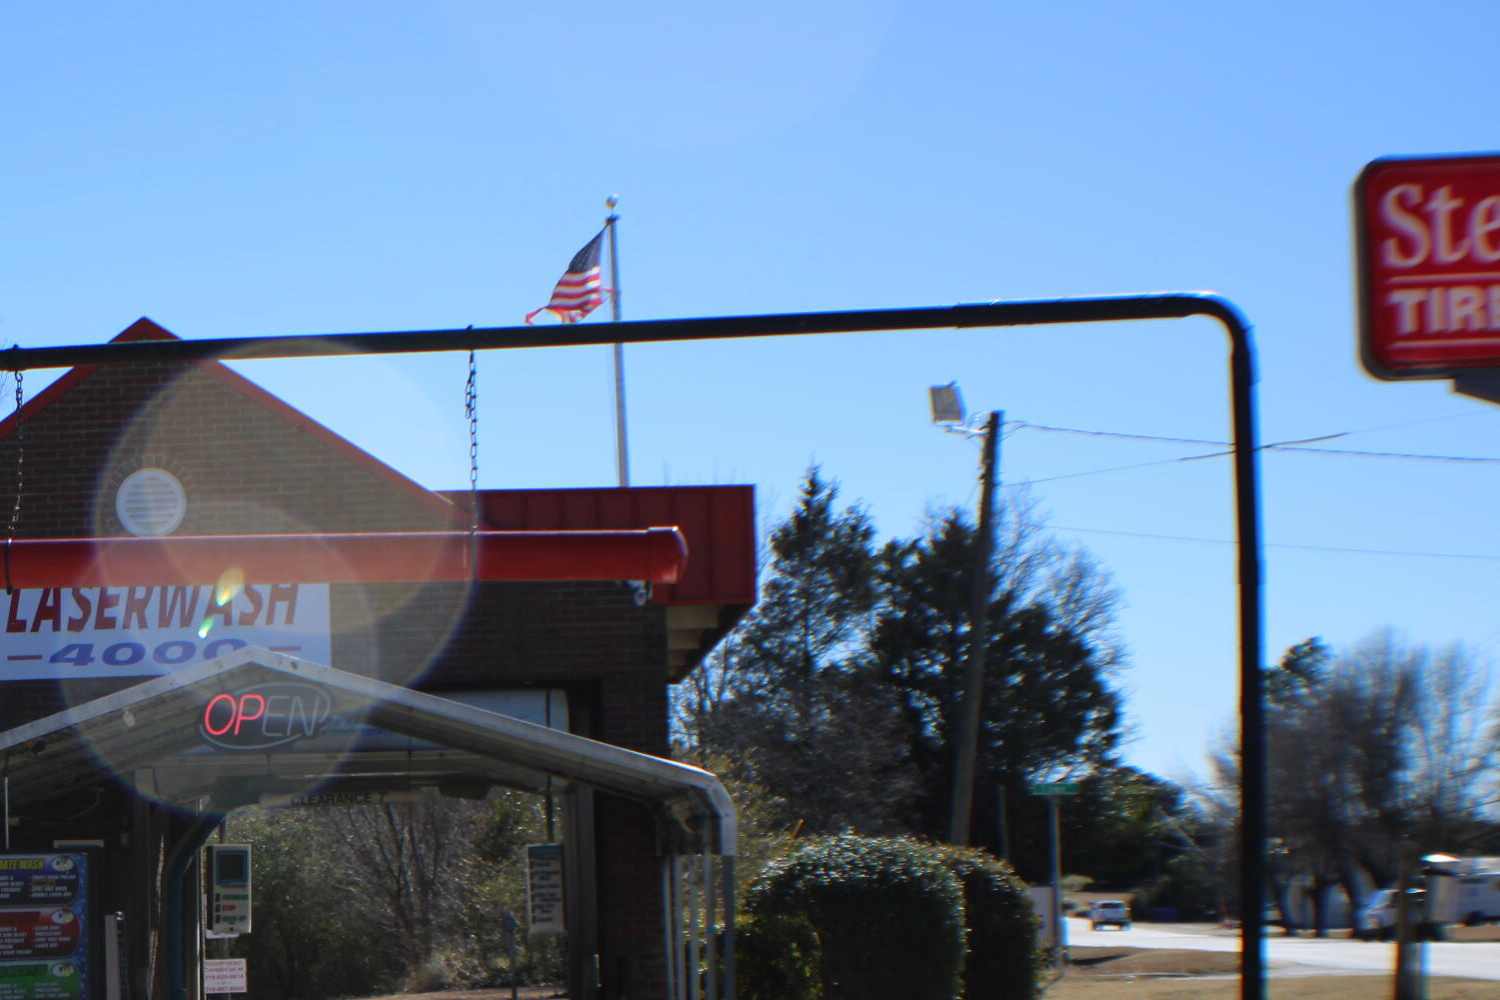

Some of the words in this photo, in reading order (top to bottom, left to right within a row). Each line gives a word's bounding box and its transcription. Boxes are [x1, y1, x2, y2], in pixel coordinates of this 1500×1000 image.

[6, 583, 300, 633] LASERWASH
[49, 638, 247, 666] 4000
[204, 693, 320, 738] OPEN
[291, 791, 372, 806] CLEARANCE
